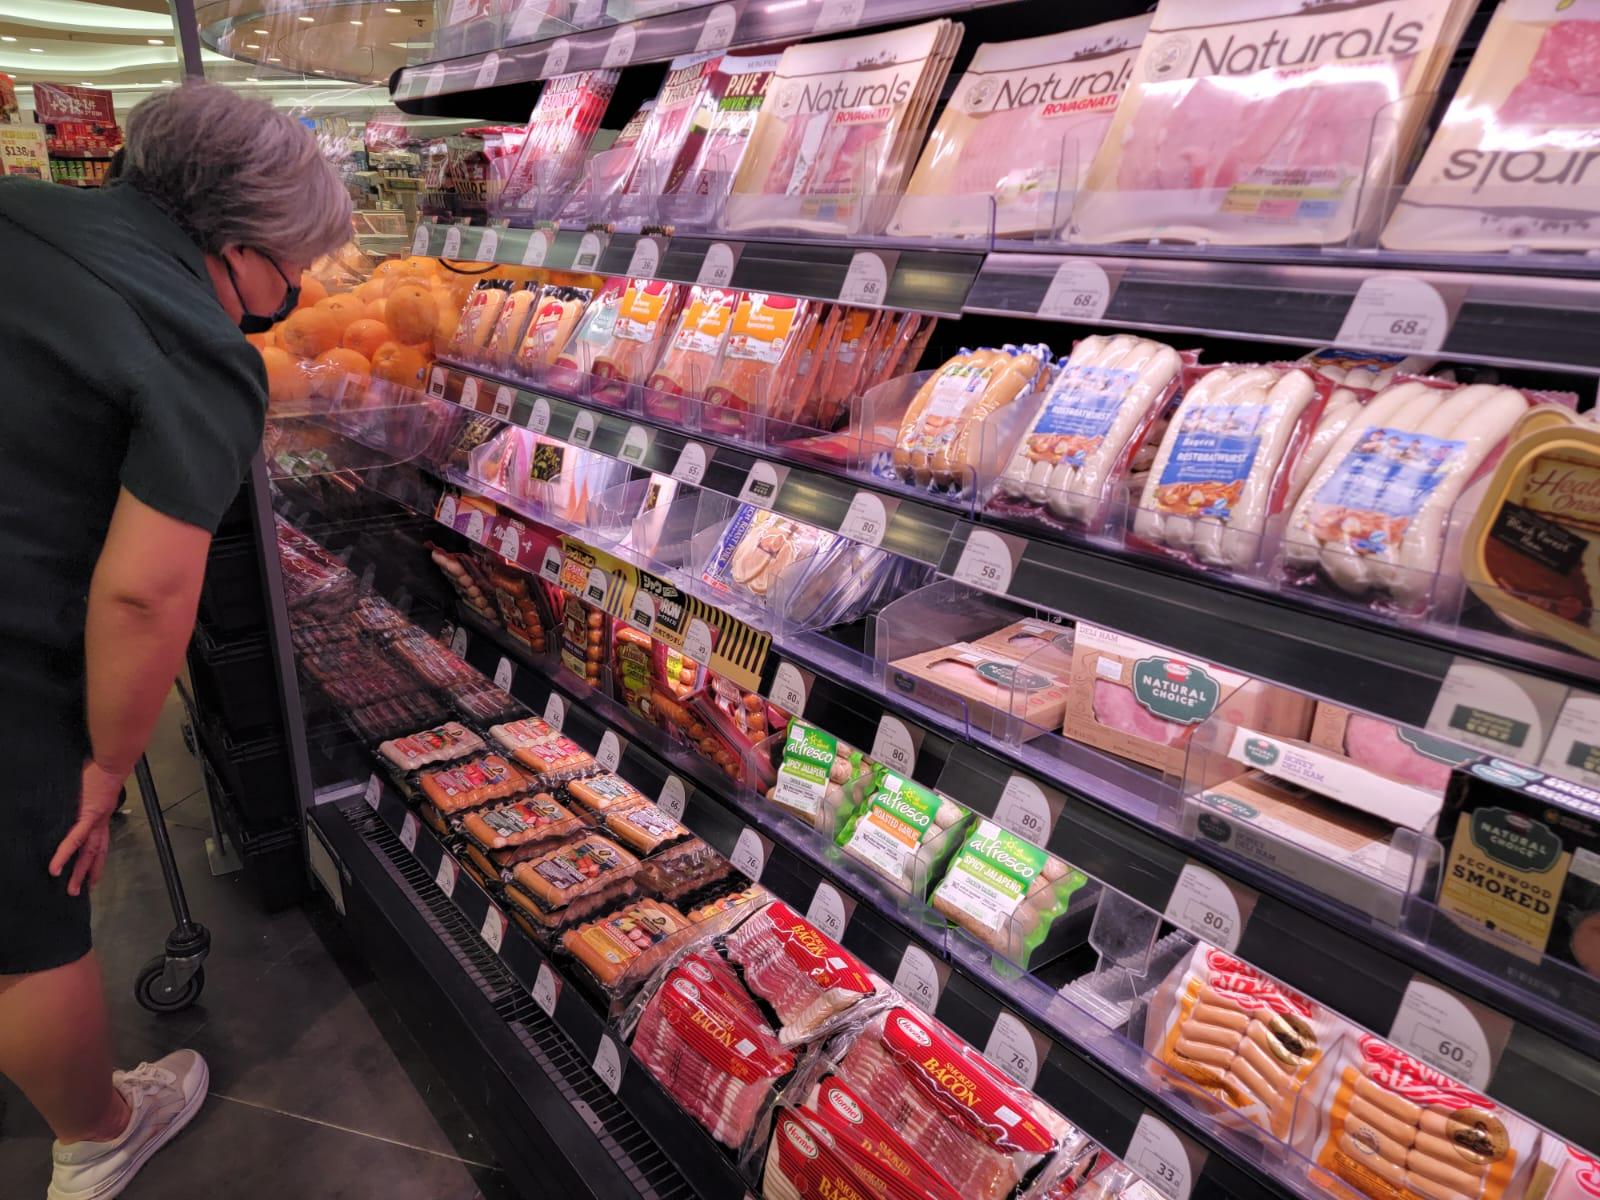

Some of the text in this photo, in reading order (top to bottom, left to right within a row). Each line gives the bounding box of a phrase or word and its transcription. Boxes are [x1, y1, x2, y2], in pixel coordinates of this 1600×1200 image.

[1188, 12, 1424, 78] Naturals
[796, 73, 911, 114] Naturals
[1042, 94, 1118, 116] ROVAGNATI
[1098, 631, 1119, 643] HAM
[1142, 674, 1207, 702] NATURAL
[1152, 687, 1196, 707] CHOICE
[1480, 821, 1548, 856] NATURAL
[1490, 836, 1536, 858] CHOICE
[963, 855, 985, 872] SPICY
[1458, 854, 1552, 900] PECANWOOD
[1451, 863, 1550, 915] SMOKED
[792, 924, 826, 957] BACON
[690, 1010, 737, 1048] BACON
[902, 1020, 931, 1046] Hormel
[922, 1056, 982, 1107] BACON
[945, 1061, 977, 1091] SMOKED
[831, 1091, 861, 1121] Hormel
[787, 1123, 815, 1154] Hormel
[879, 1140, 911, 1177] SMOKED
